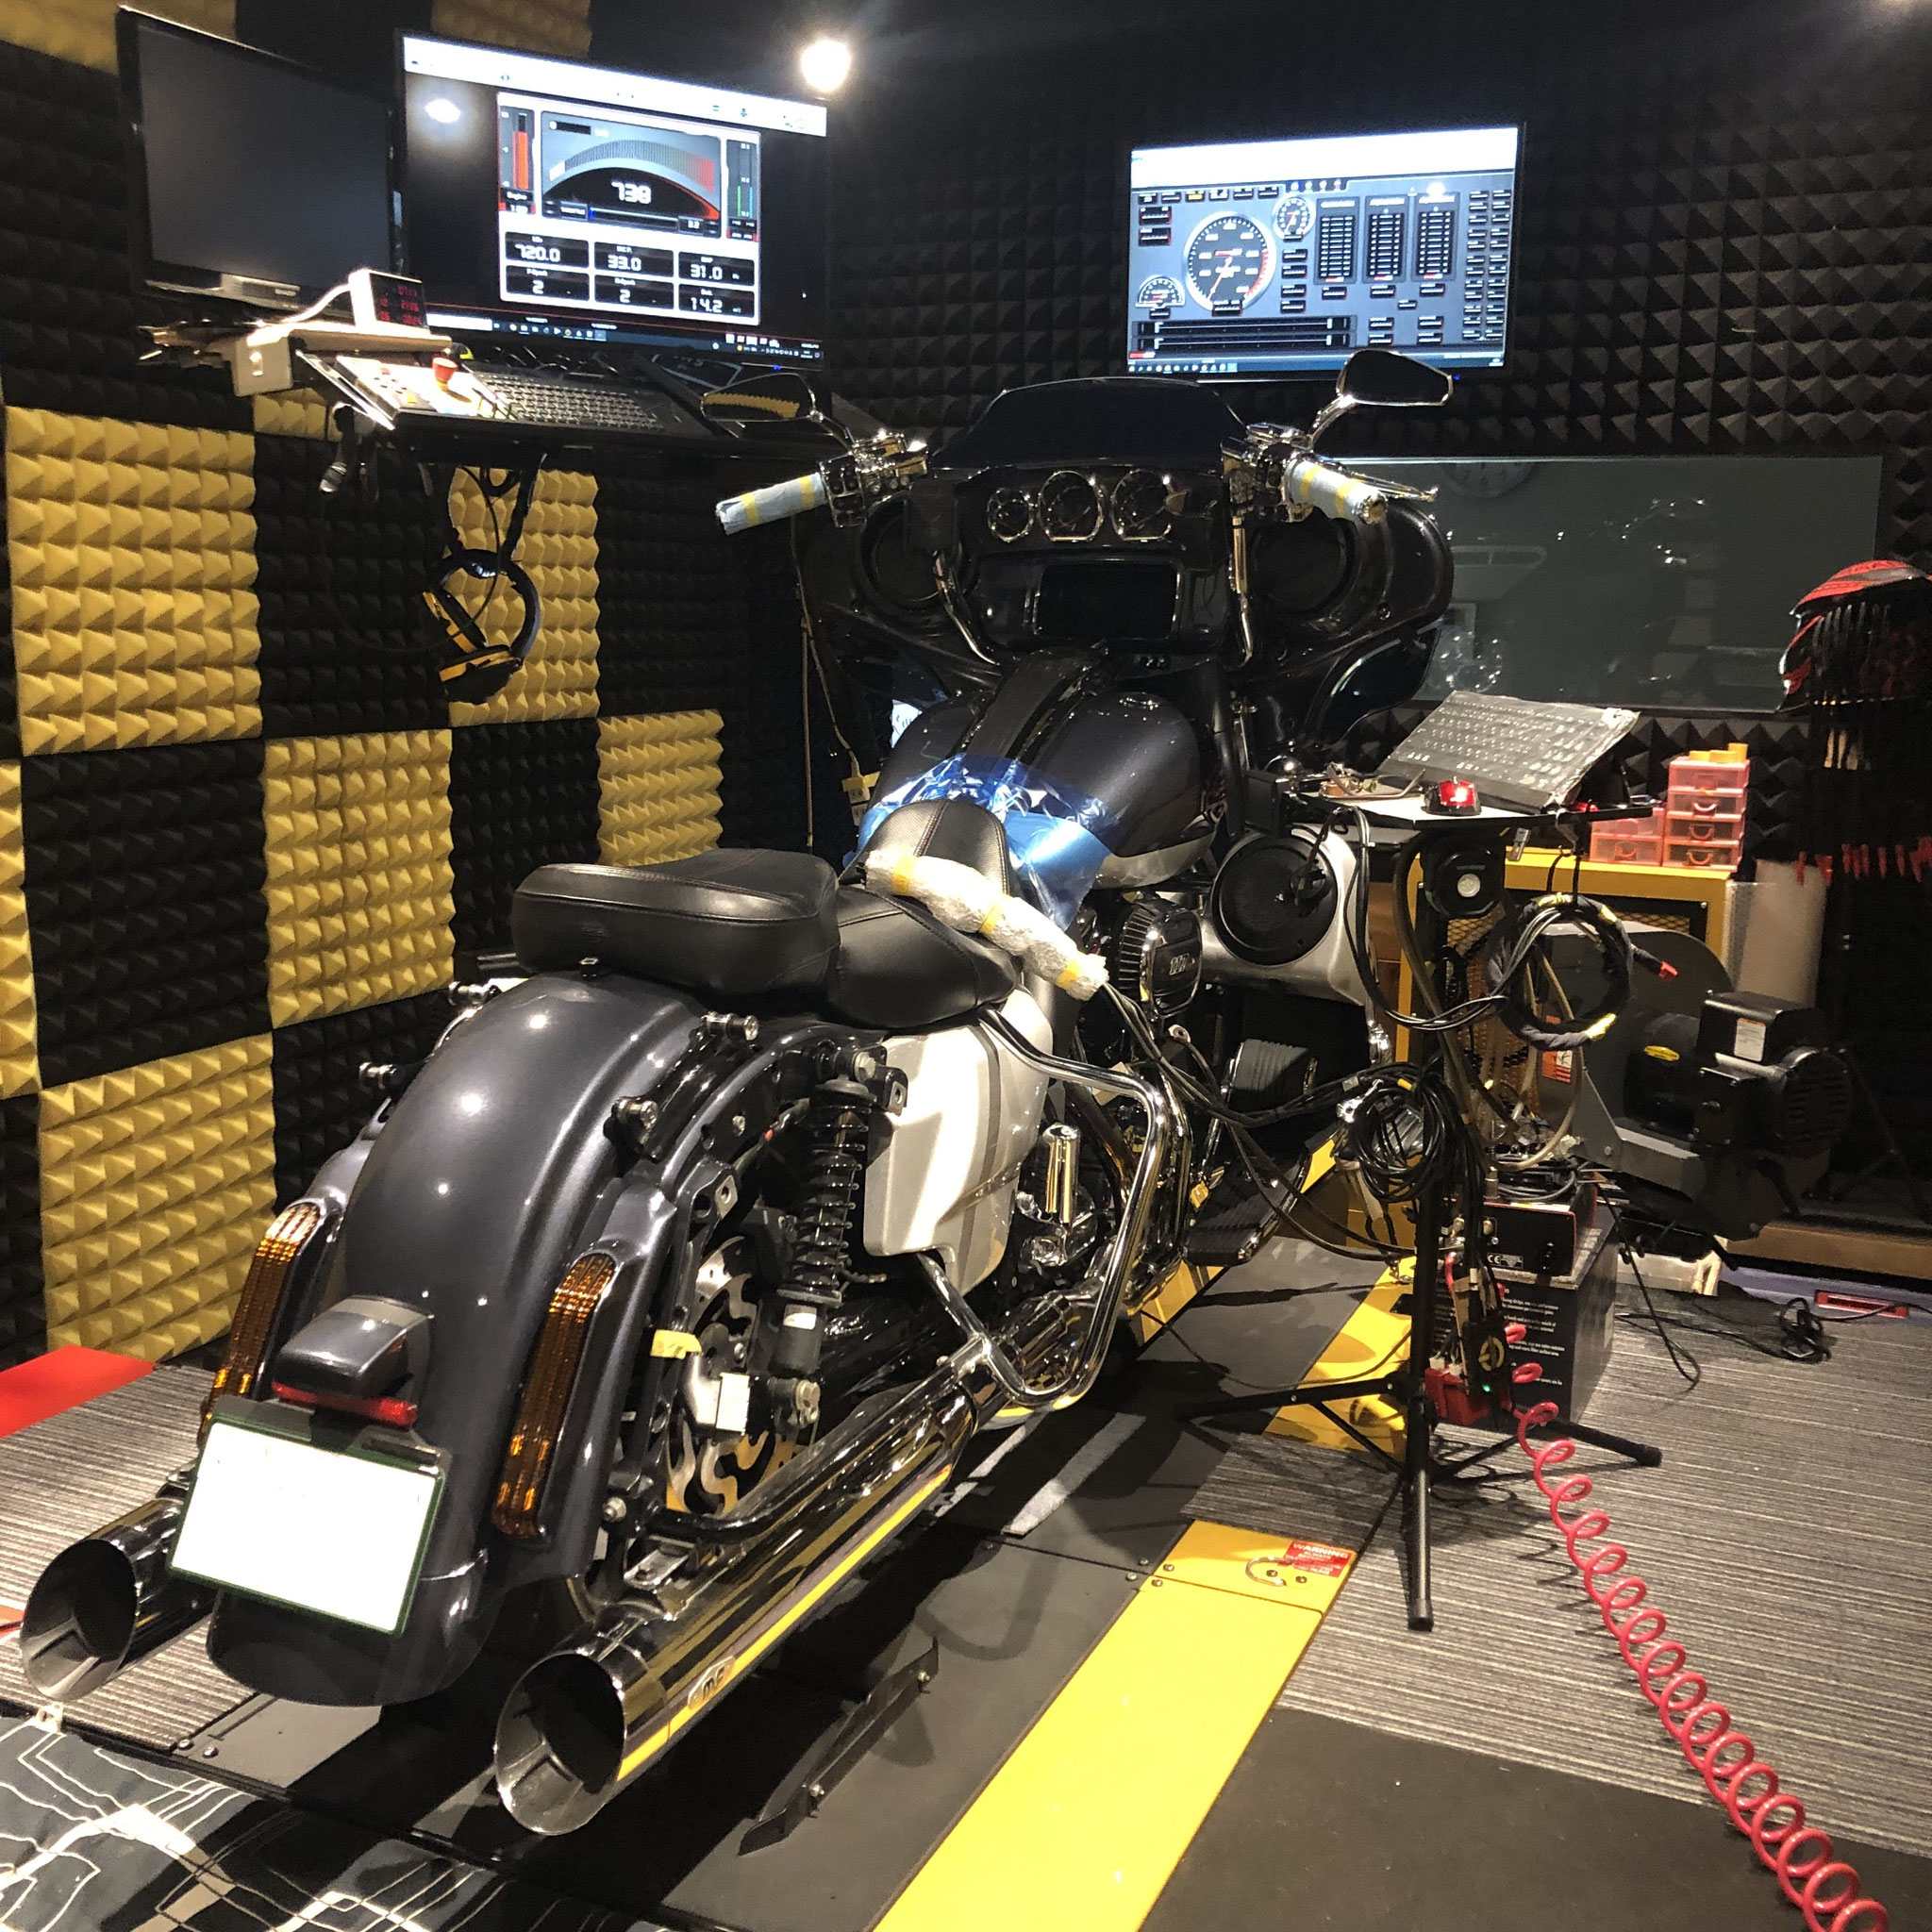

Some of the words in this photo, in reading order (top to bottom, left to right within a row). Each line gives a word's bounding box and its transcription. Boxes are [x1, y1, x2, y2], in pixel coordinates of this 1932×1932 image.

[611, 181, 652, 205] 738
[514, 243, 561, 263] 720.0
[608, 254, 642, 272] 33.0
[690, 263, 724, 281] 31.0
[532, 279, 544, 295] 2
[619, 289, 631, 304] 2
[690, 296, 724, 313] 14.2
[1293, 1543, 1349, 1558] WARNING
